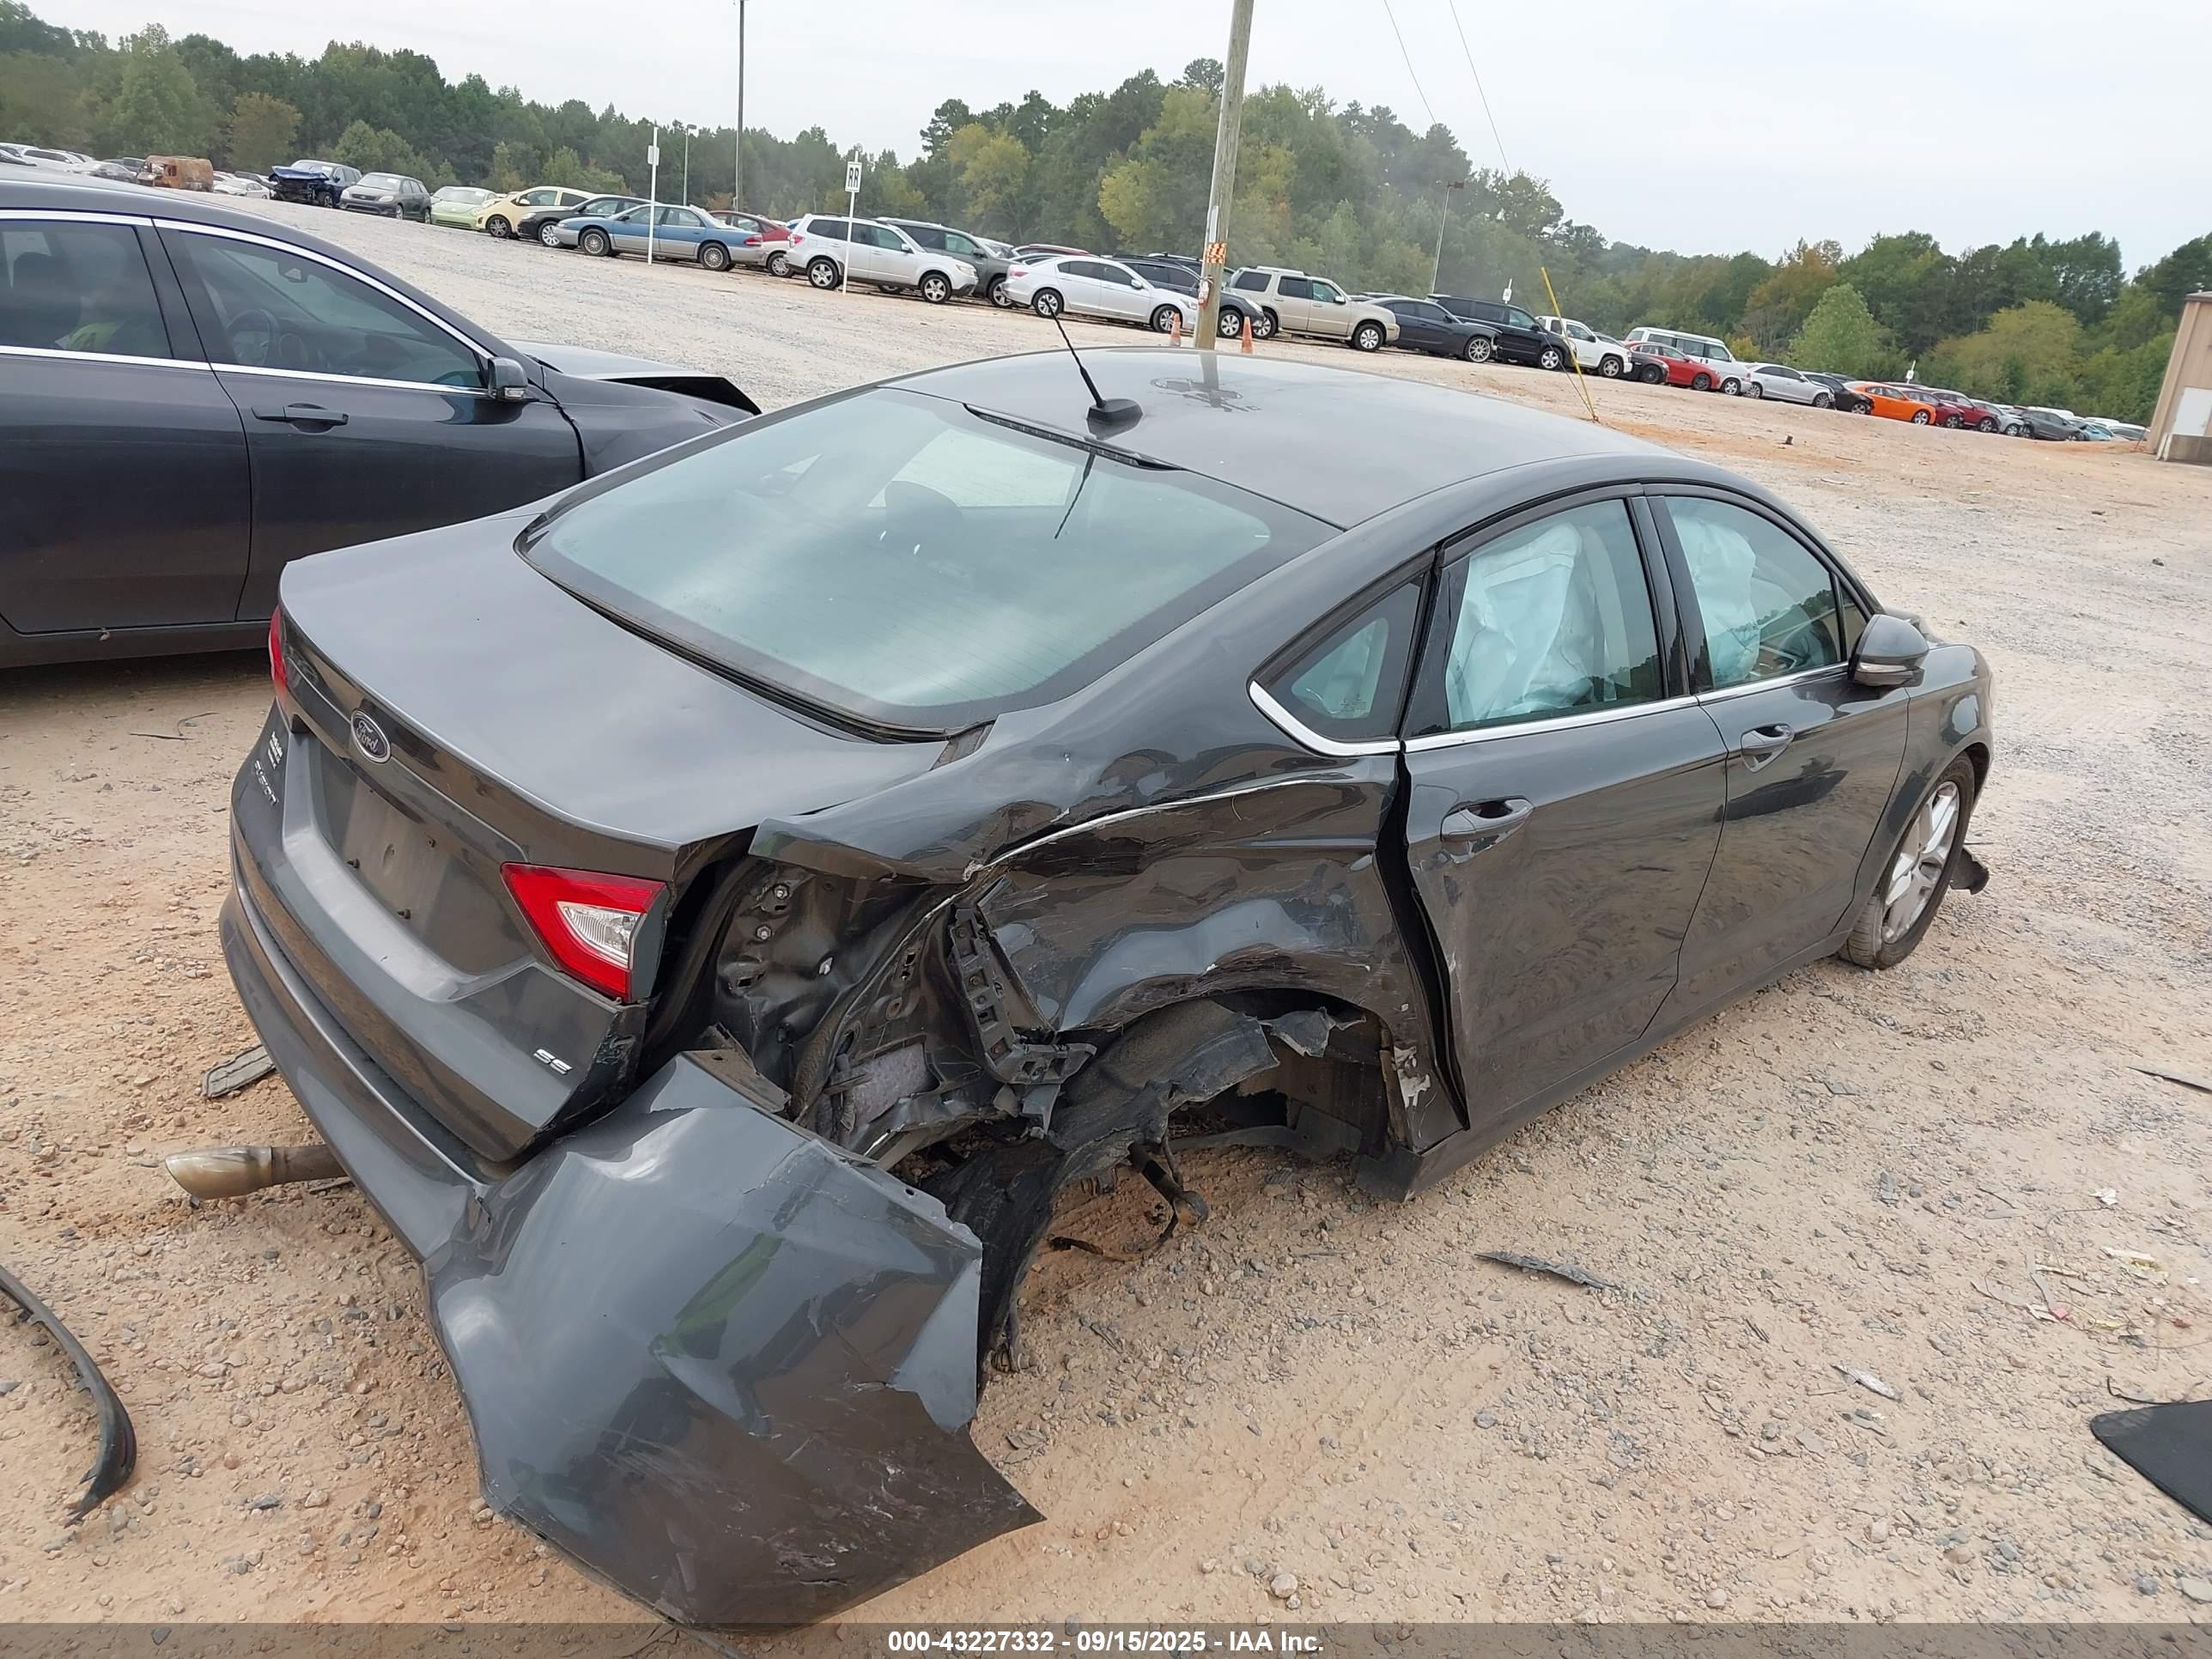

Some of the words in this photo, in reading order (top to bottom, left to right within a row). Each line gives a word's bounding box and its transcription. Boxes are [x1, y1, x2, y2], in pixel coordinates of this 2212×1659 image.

[848, 167, 860, 188] RR
[356, 720, 379, 753] Ford
[533, 1048, 573, 1075] SE
